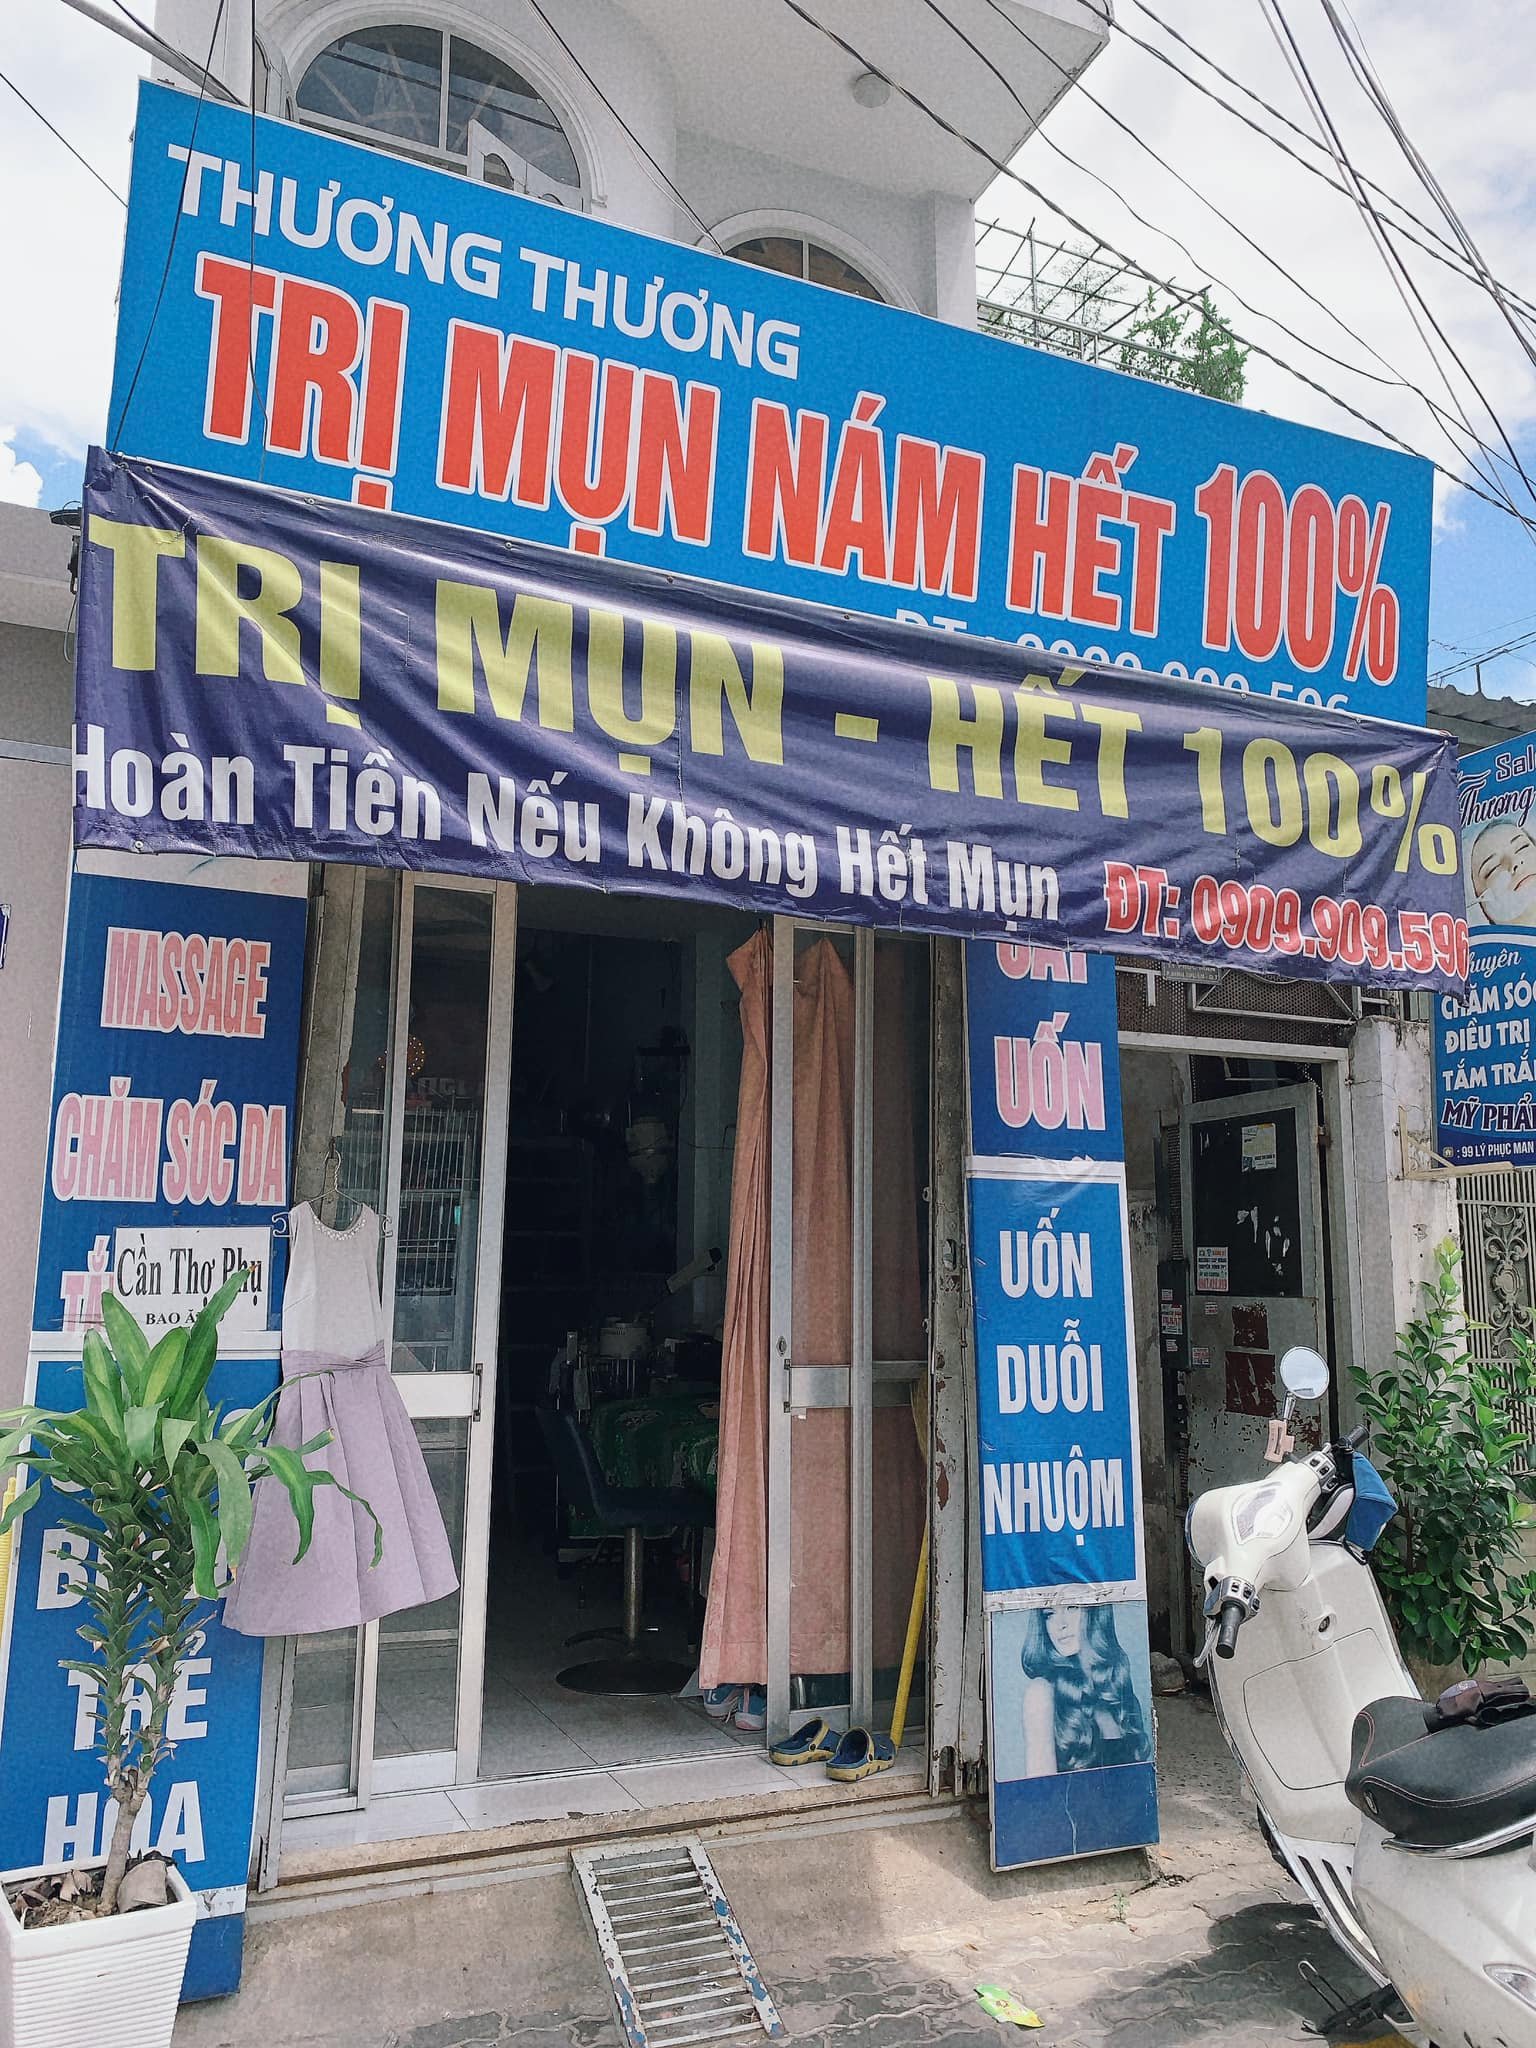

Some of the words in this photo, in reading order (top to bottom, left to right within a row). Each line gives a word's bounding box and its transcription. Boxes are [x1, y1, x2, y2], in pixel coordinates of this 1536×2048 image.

[168, 144, 502, 299] THƯƠNG
[520, 249, 801, 379] THƯƠNG
[195, 252, 410, 511] TRỊ
[436, 317, 720, 554] MỤN
[742, 391, 986, 602] NÁM
[1005, 443, 1176, 638] HẾT
[1195, 462, 1400, 686] 100%
[88, 515, 362, 729] TRỊ
[435, 579, 786, 775] MỤN
[926, 666, 1142, 819] HẾT
[1183, 727, 1459, 876] 100%
[1495, 744, 1536, 781] Sal
[71, 724, 255, 826] Hoàn
[284, 745, 441, 842] Tiền
[467, 769, 601, 863] Nếu
[627, 792, 819, 898] Không
[838, 823, 928, 905] Hết
[947, 841, 1060, 931] Mụn
[1104, 861, 1180, 939] ĐT:
[1190, 875, 1470, 981] 0909.909.596
[1468, 948, 1522, 978] huyên
[101, 927, 271, 1038] MASSAGE
[1441, 983, 1500, 1020] CHĂM
[1503, 972, 1536, 1010] SÓ
[994, 1012, 1106, 1131] UỐN
[1442, 1058, 1488, 1091] TẮM
[1491, 1048, 1536, 1086] TRẮ
[1445, 1017, 1492, 1054] ĐIỀU
[1496, 1018, 1531, 1048] TRỊ
[51, 1077, 165, 1202] CHĂM
[163, 1079, 238, 1206] SÓC
[237, 1104, 287, 1207] DA
[1441, 1096, 1481, 1128] MỸ
[117, 1233, 162, 1297] Cần
[170, 1248, 216, 1307] Thợ
[999, 1208, 1093, 1298] UỐN
[146, 1312, 181, 1325] BAO
[996, 1318, 1104, 1414] DUỖI
[983, 1445, 1125, 1546] NHUỘM
